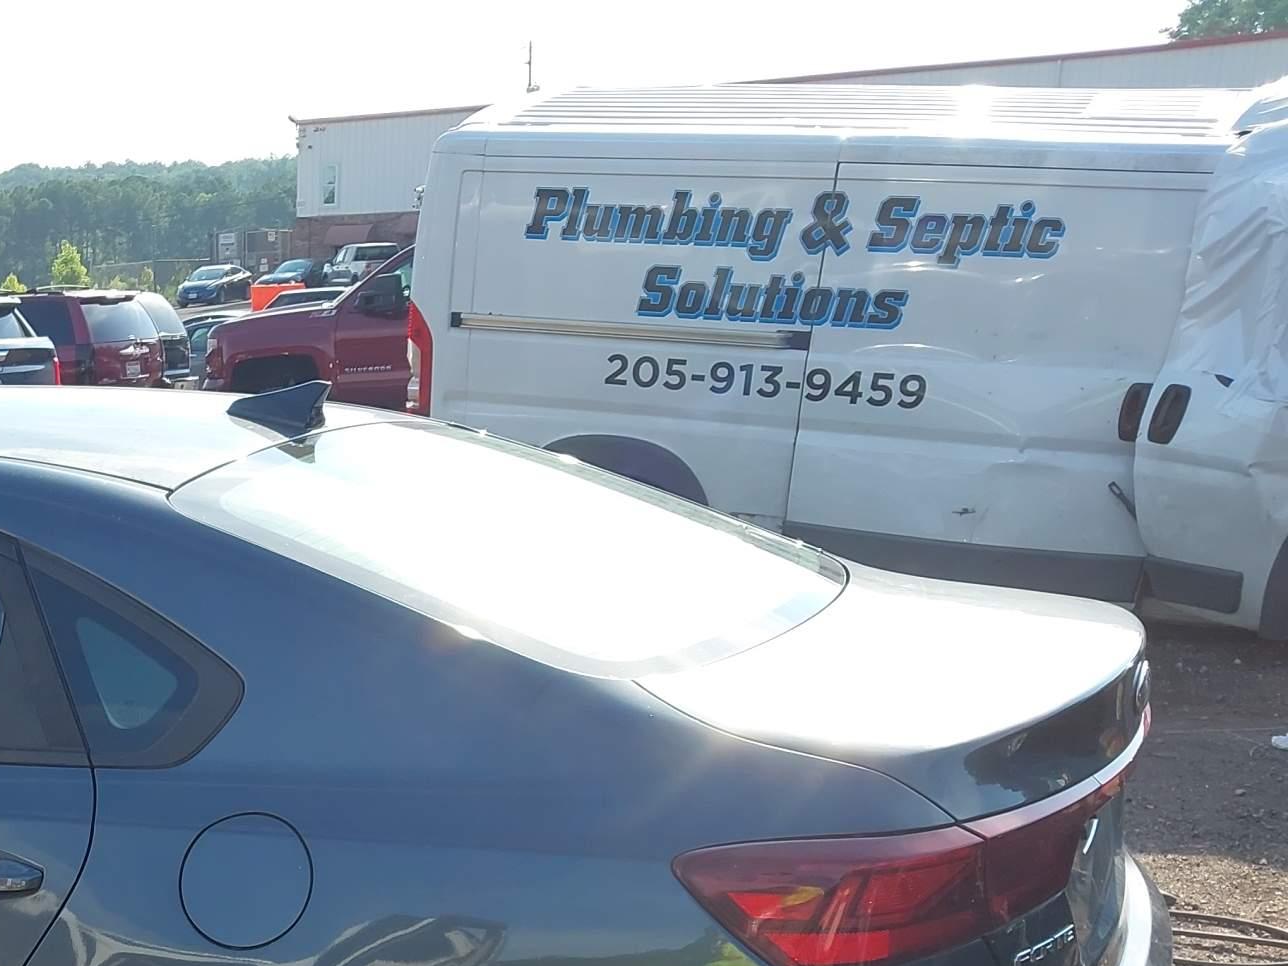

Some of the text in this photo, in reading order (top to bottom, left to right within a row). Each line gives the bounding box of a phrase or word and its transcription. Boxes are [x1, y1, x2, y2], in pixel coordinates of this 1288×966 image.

[524, 186, 1066, 269] Plumbing & Septic
[635, 263, 909, 330] Solutions
[604, 353, 927, 410] 205-913-9459
